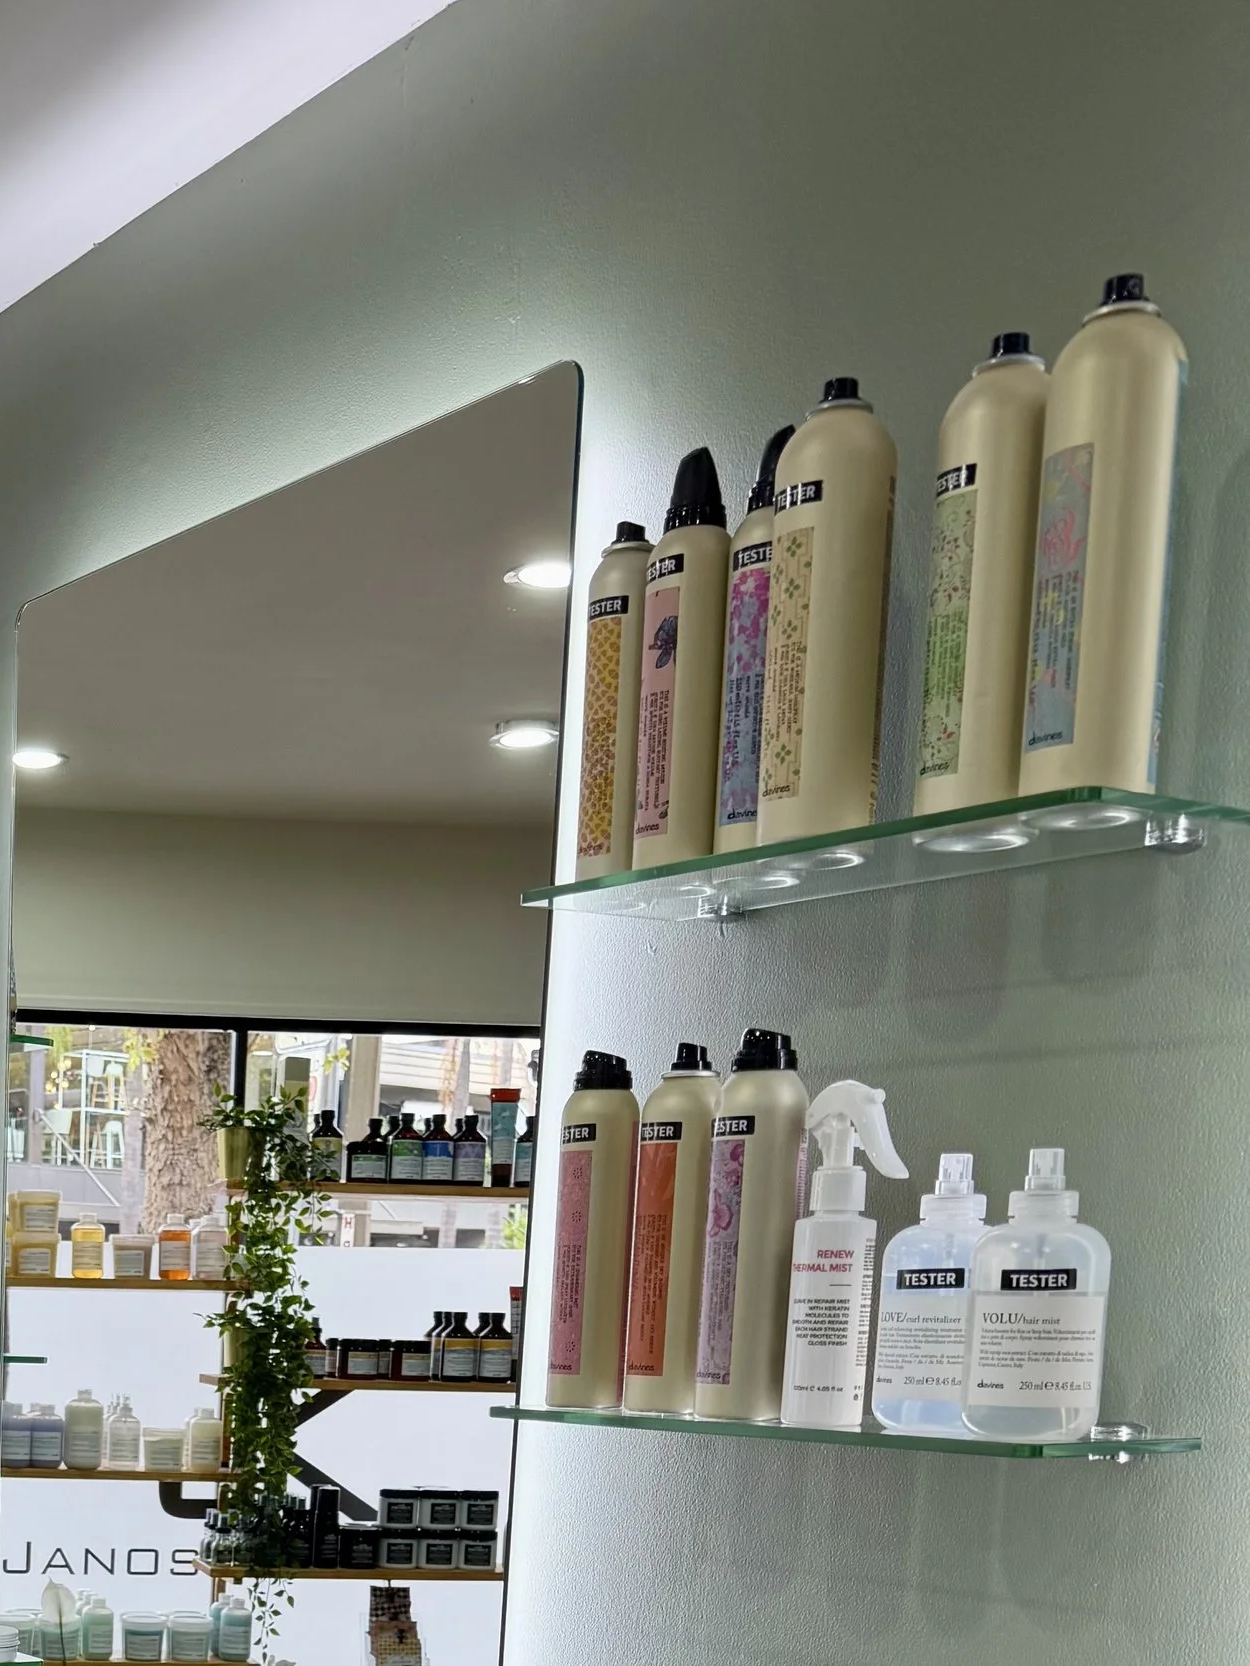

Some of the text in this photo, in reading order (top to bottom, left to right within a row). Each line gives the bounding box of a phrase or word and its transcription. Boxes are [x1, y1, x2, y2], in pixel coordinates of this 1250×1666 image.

[647, 559, 676, 581] ESTER
[727, 808, 757, 820] davine
[714, 1119, 747, 1133] ESTER
[561, 1127, 589, 1141] ESTER
[817, 1250, 854, 1259] RENEW
[793, 1264, 853, 1272] HERMAL MIST
[904, 1273, 956, 1286] TESTER
[1010, 1274, 1068, 1288] TESTER
[1042, 1316, 1061, 1325] mist
[3, 1541, 199, 1576] JANOS
